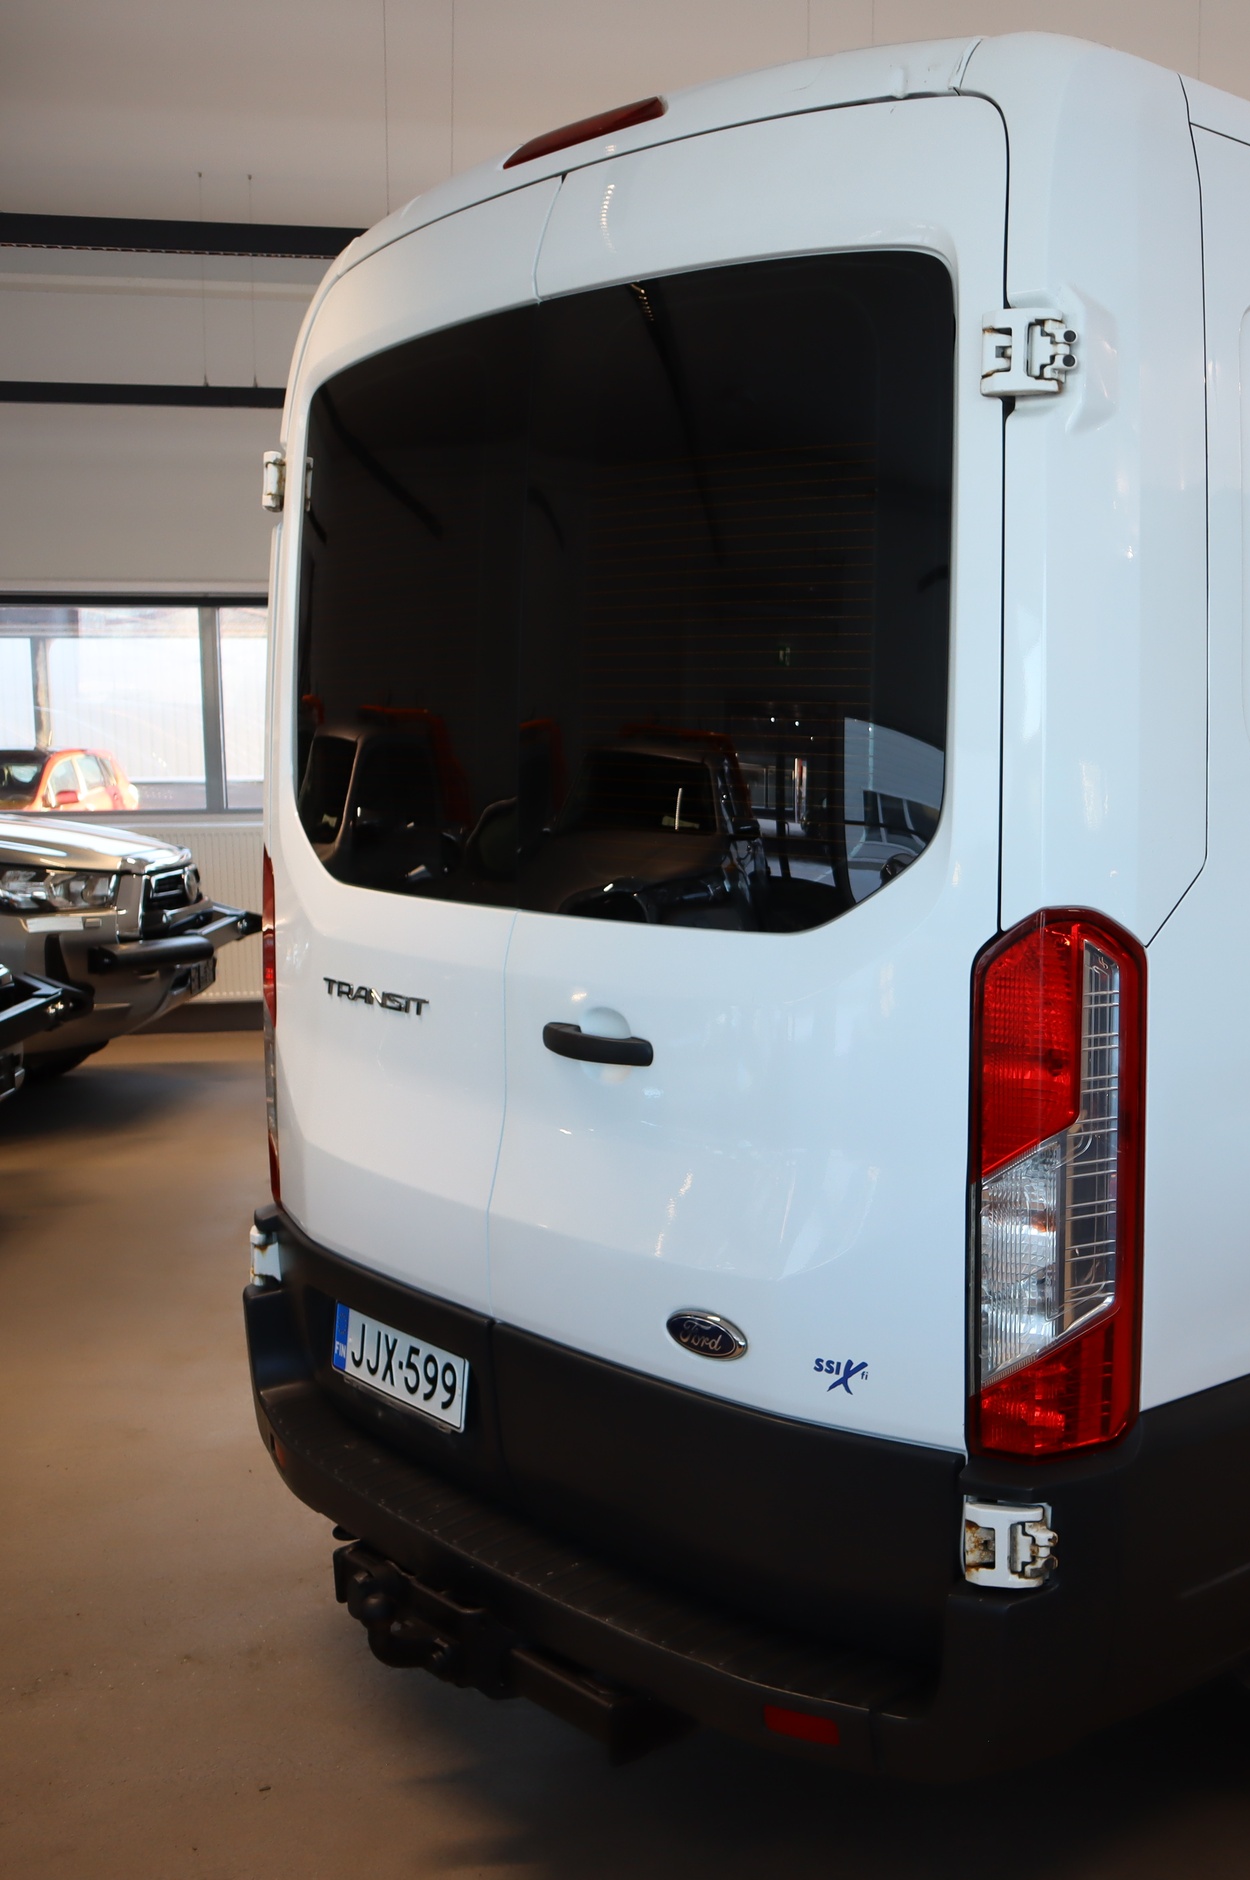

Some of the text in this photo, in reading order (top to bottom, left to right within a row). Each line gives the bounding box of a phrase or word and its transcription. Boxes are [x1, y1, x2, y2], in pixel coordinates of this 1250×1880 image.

[323, 976, 429, 1016] TRANSIT
[334, 1340, 347, 1358] FIN
[679, 1319, 722, 1352] Ford
[351, 1322, 457, 1410] JJX-599
